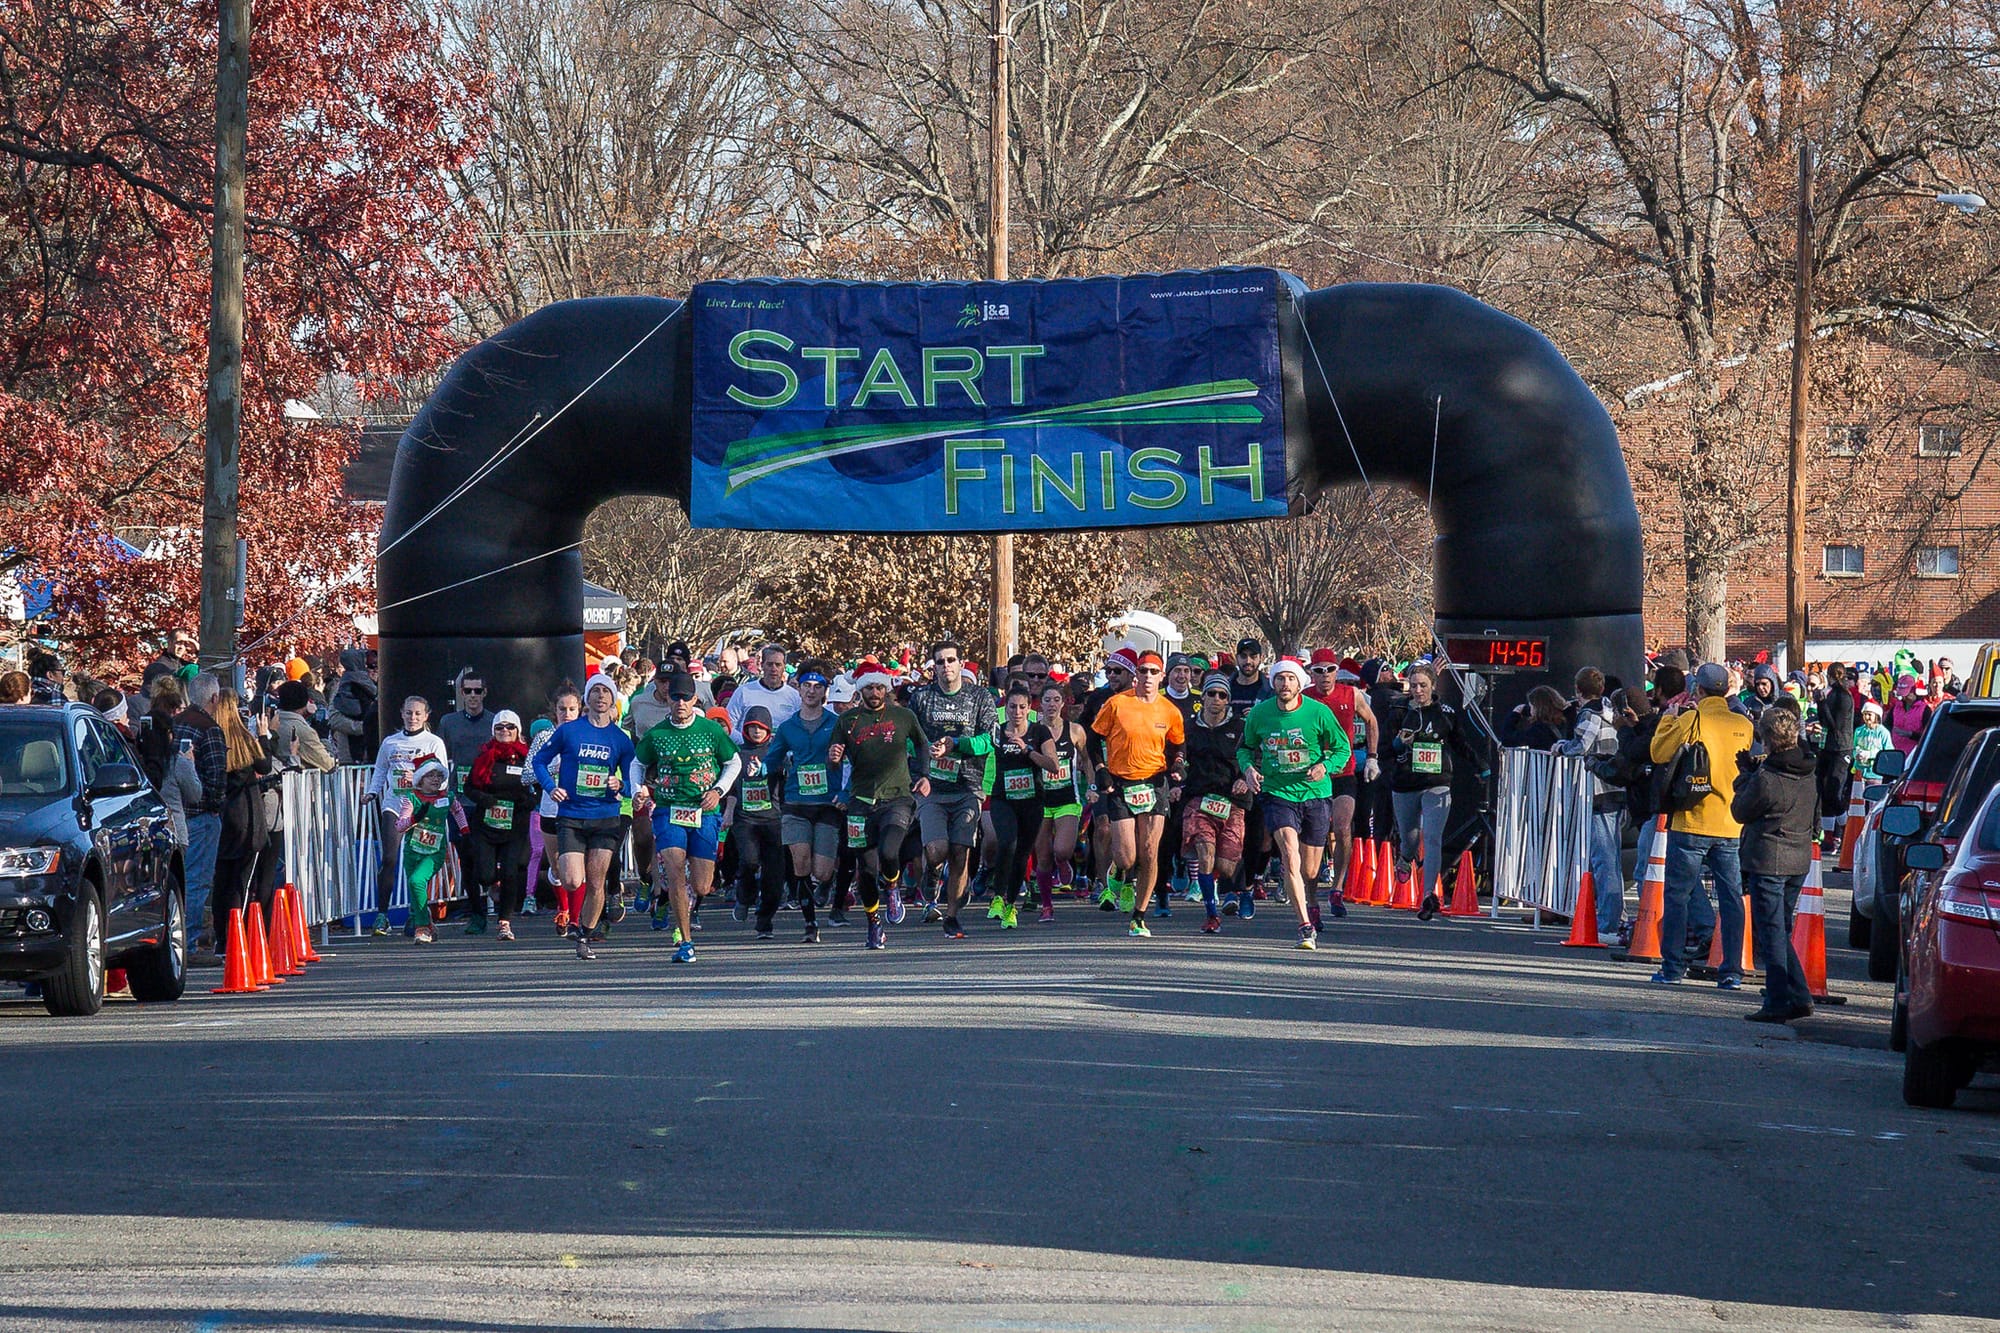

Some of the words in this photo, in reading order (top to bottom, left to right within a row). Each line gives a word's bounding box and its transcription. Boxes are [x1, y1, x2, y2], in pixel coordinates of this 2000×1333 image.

[1150, 286, 1264, 299] WWW.JANDARACING.COM
[706, 298, 728, 310] Live,
[758, 299, 785, 310] Race!
[983, 300, 1009, 321] j&a
[725, 328, 1045, 408] START
[943, 438, 1264, 515] FINISH
[578, 749, 609, 760] KPMG
[1287, 751, 1301, 763] 13
[1418, 751, 1437, 763] 387
[585, 774, 601, 787] 56
[803, 773, 821, 785] 311
[1009, 777, 1030, 790] 333
[1692, 776, 1708, 784] VCU
[490, 807, 508, 819] 134
[1206, 800, 1227, 814] 337
[419, 829, 436, 846] 128
